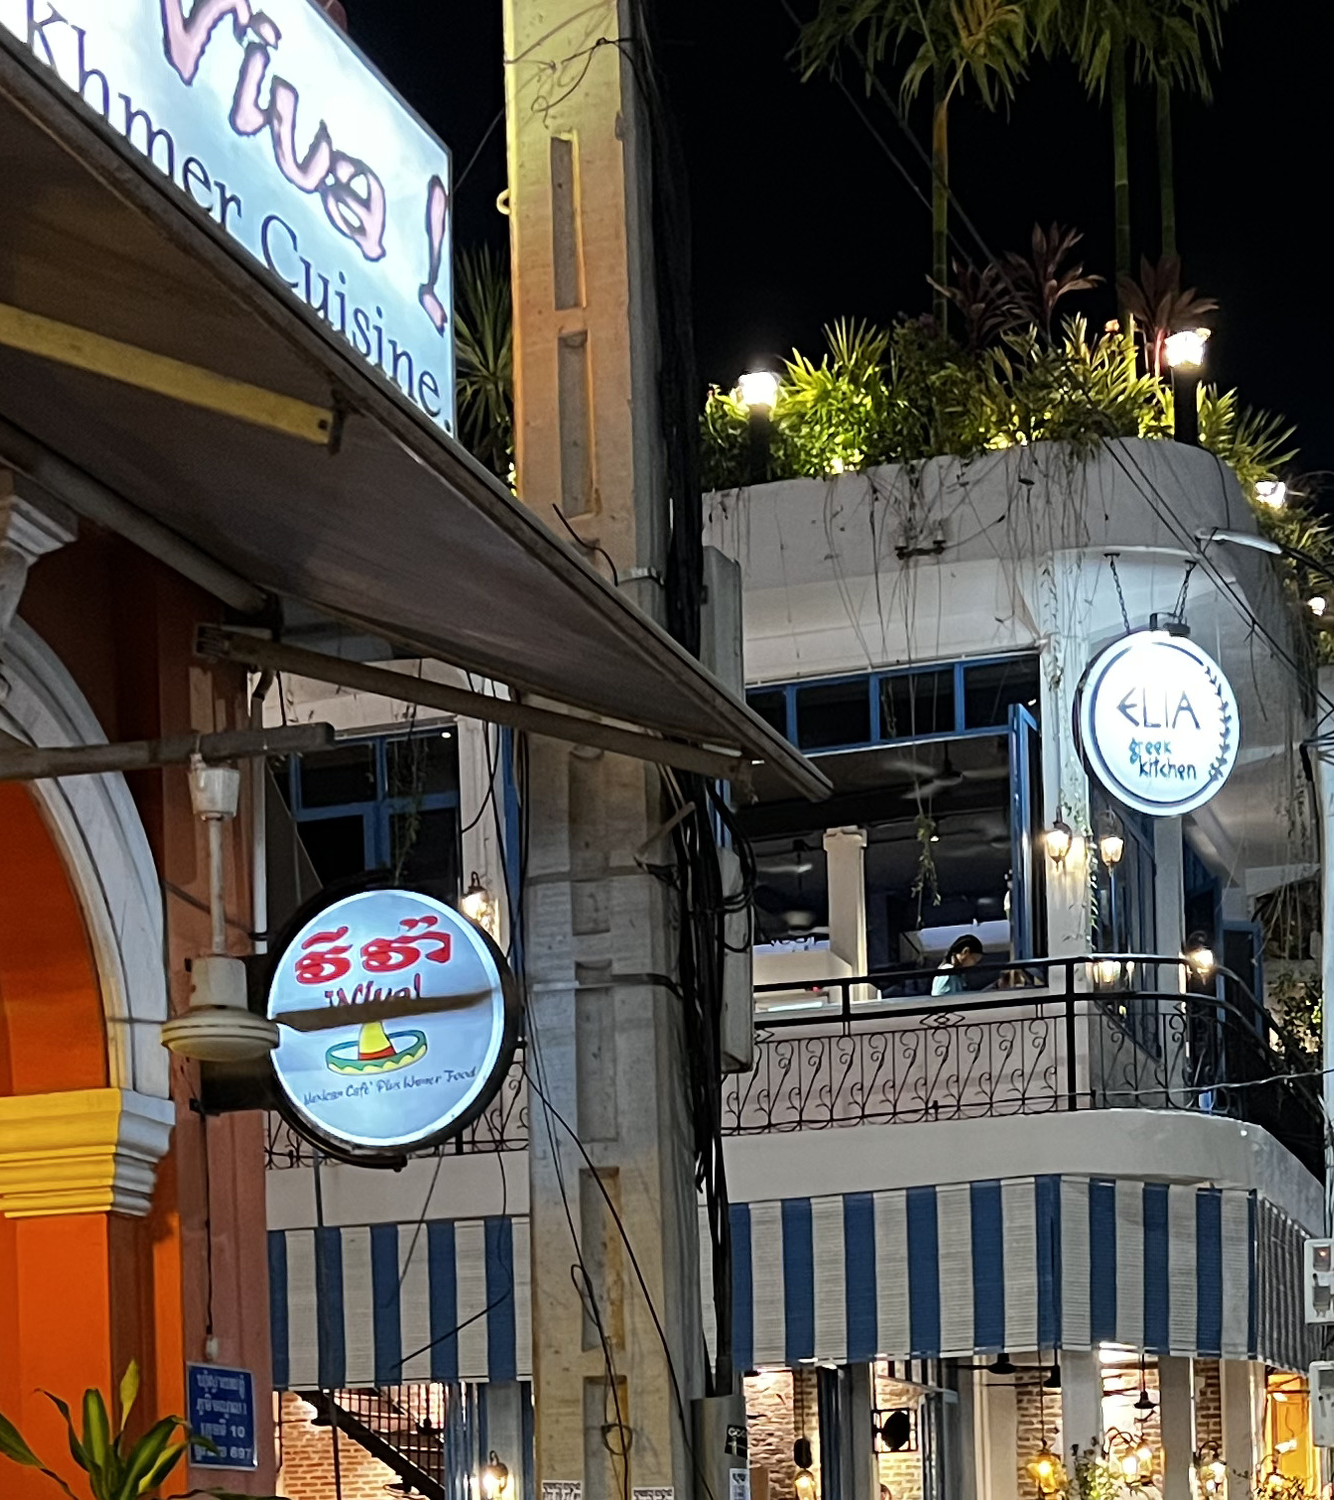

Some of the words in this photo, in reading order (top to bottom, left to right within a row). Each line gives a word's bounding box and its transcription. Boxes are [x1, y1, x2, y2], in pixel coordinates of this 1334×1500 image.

[25, 0, 243, 229] Khmer
[1116, 686, 1201, 730] ELIA
[1128, 737, 1172, 765] greek
[1138, 755, 1198, 781] kitchen
[443, 1066, 477, 1083] Food
[229, 1424, 247, 1439] 10
